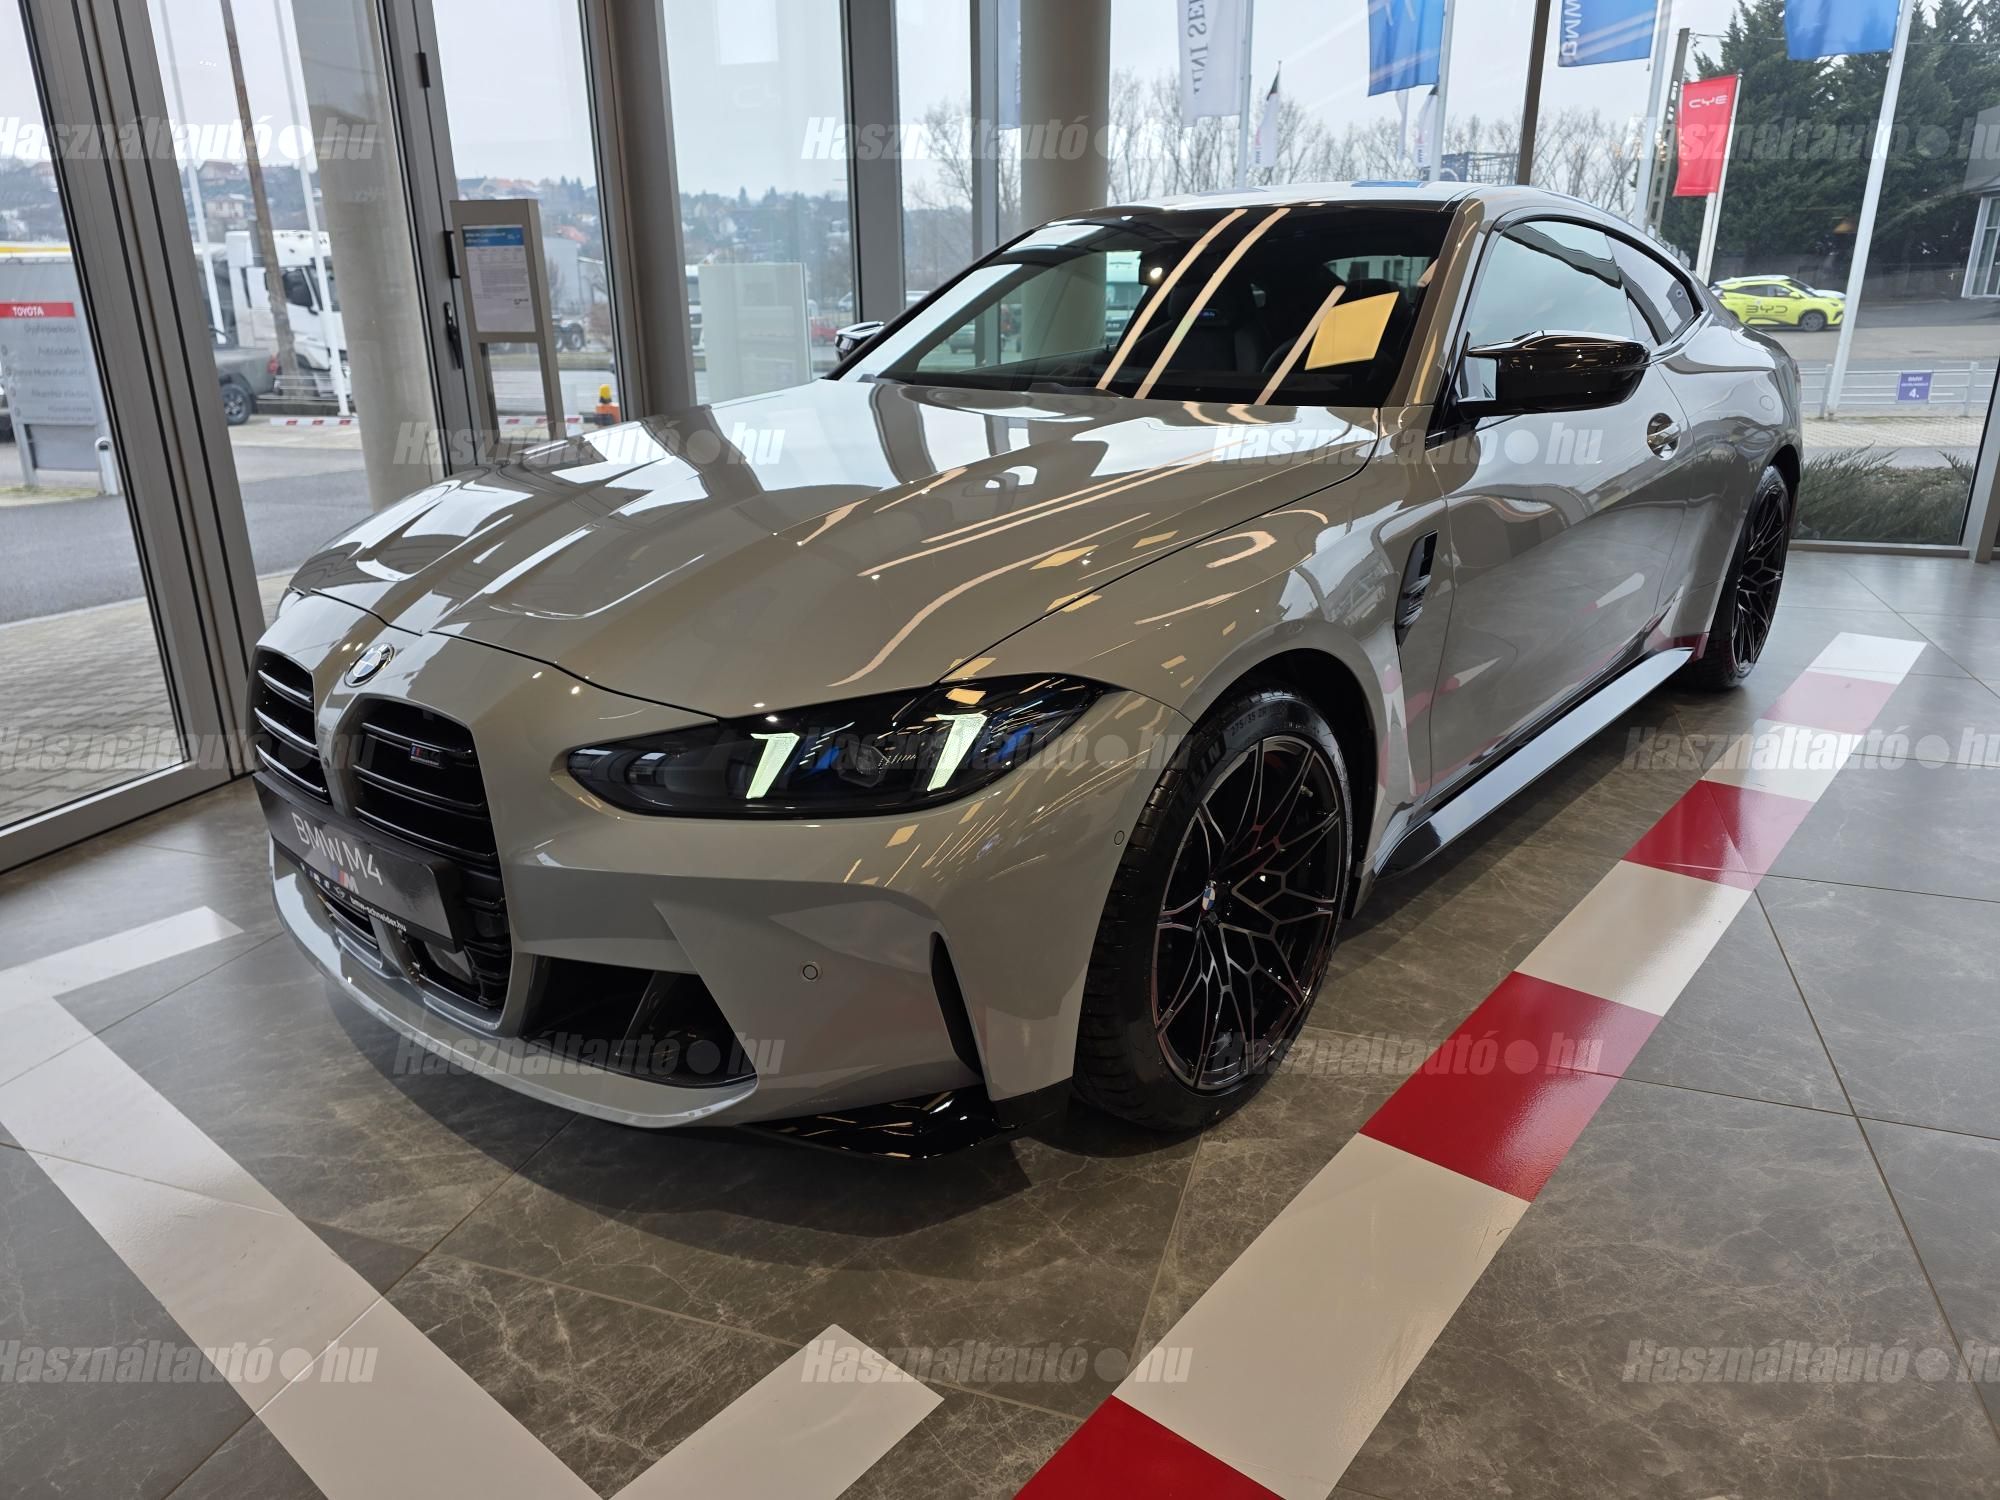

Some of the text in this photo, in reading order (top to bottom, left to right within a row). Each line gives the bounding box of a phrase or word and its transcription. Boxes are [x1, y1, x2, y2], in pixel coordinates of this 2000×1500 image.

[12, 306, 45, 317] TOYOTA
[1745, 304, 1789, 314] BYD
[292, 812, 343, 867] BMW
[342, 840, 384, 886] M4
[350, 896, 407, 932] bmw-schneider.hu
